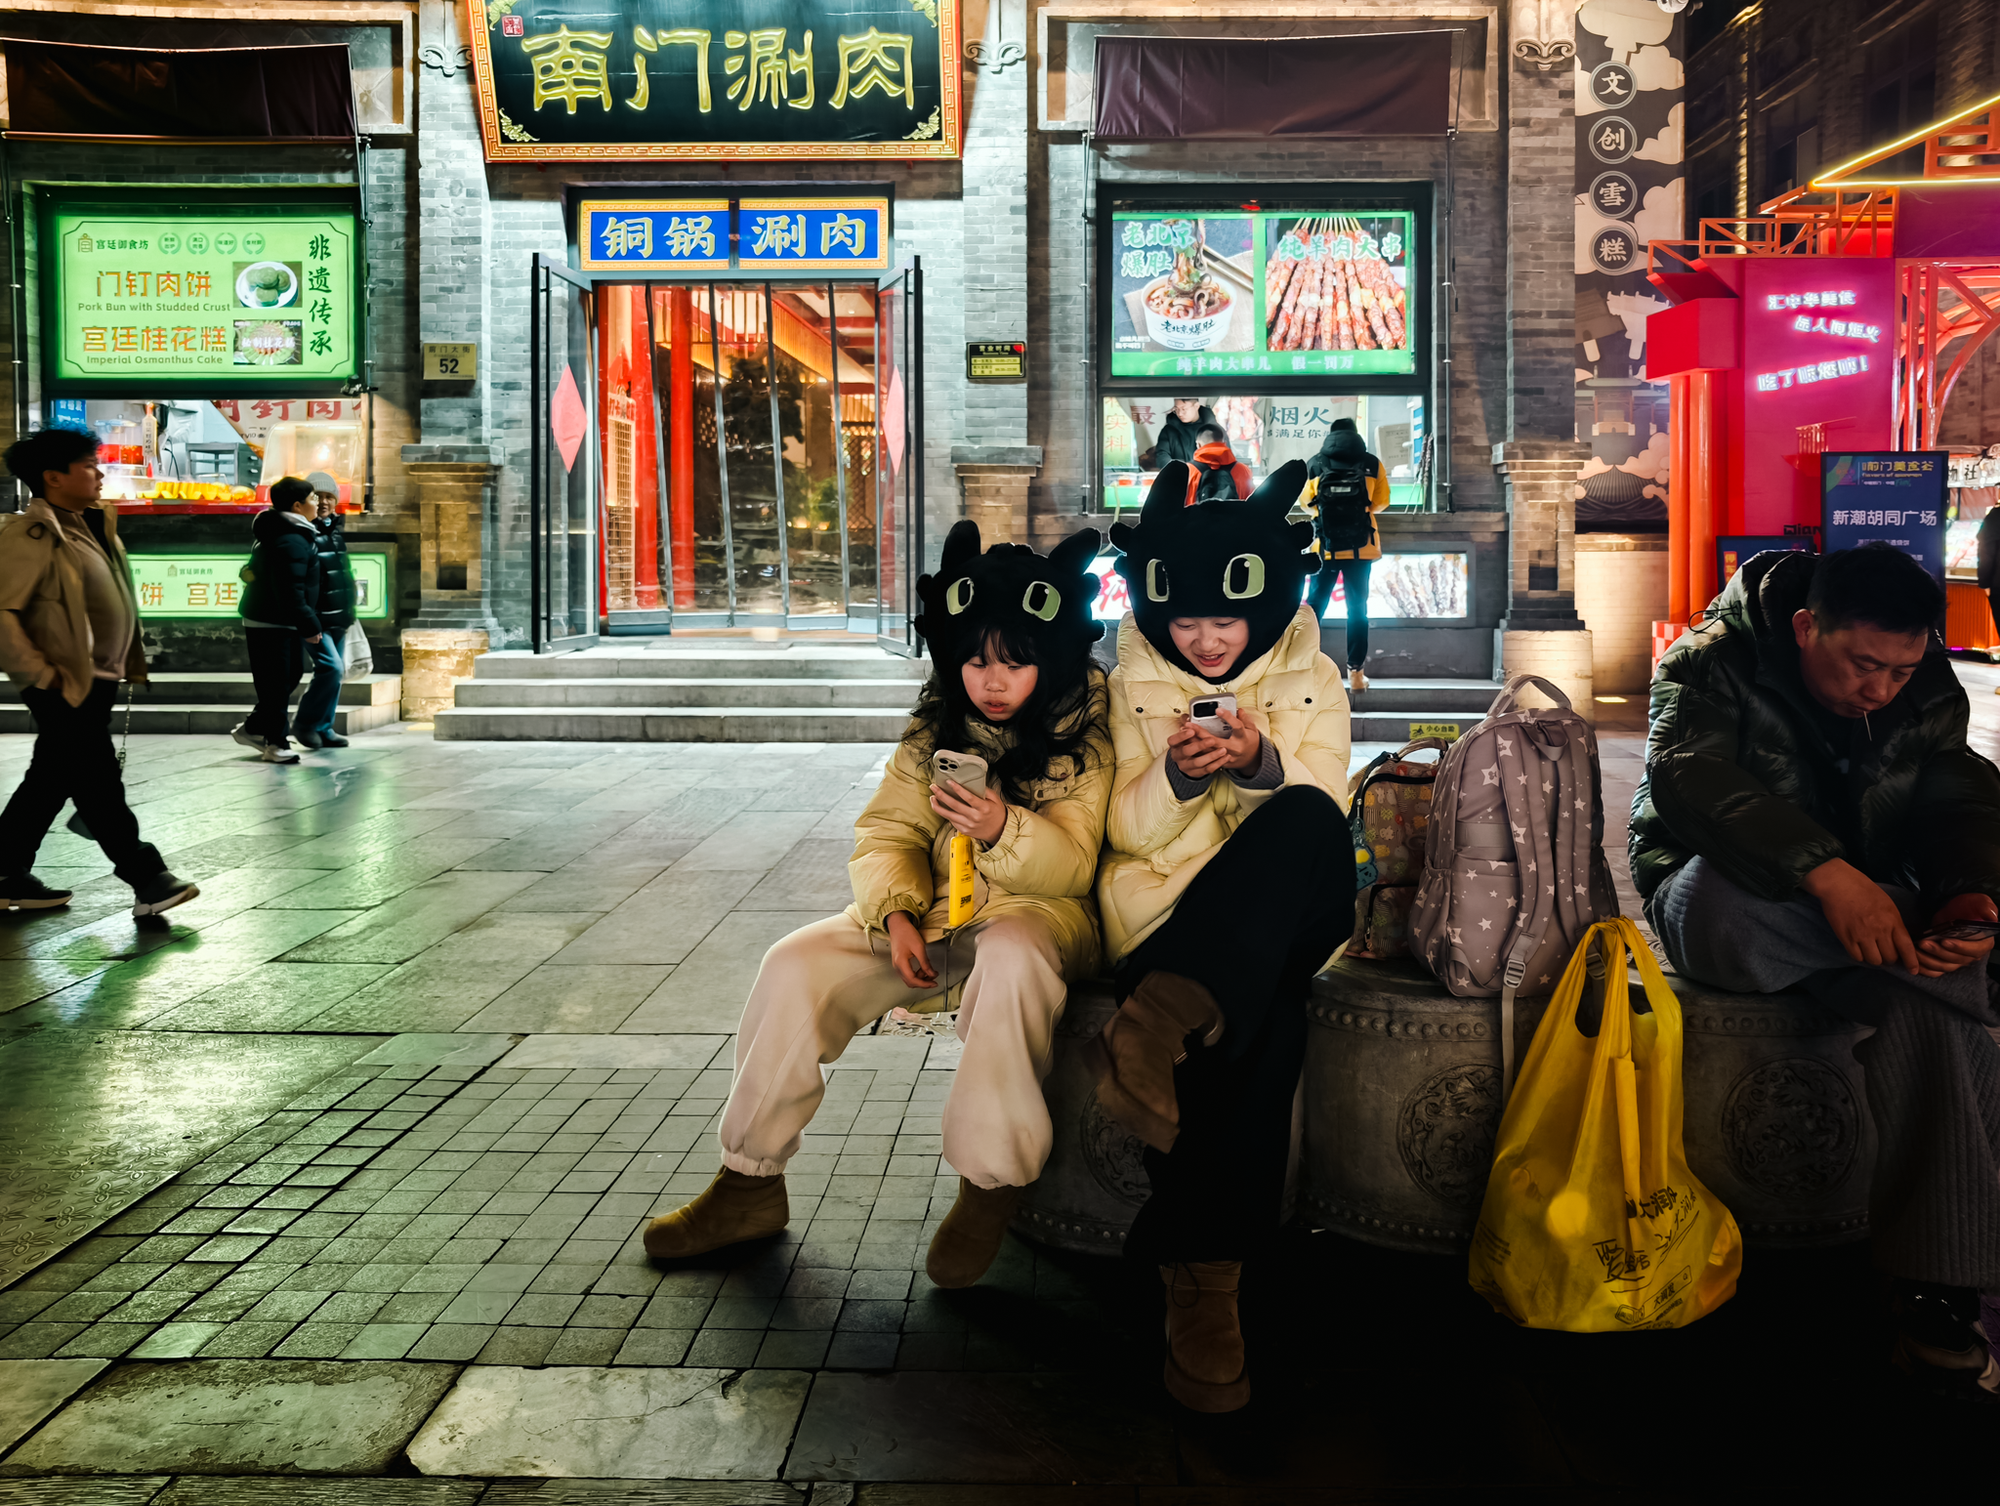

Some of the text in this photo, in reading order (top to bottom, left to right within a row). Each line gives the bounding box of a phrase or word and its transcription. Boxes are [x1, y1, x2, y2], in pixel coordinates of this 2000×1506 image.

[521, 24, 915, 115] 南门涮肉
[1597, 71, 1629, 263] 文创雪糕
[96, 239, 149, 250] 宫廷御食坊
[598, 213, 867, 259] 铜锅 涮肉
[1121, 221, 1195, 249] 老北京
[1278, 232, 1402, 262] 纯羊肉大串
[1121, 249, 1173, 278] 爆肚
[96, 271, 212, 297] 门钉肉饼
[308, 233, 333, 356] 非遗传承
[78, 303, 230, 311] Pork Bun with Studded Crust
[82, 326, 226, 352] 宫廷桂花糕
[1161, 319, 1215, 335] 老北京爆肚
[87, 355, 223, 365] Imperial Osmanthus Cake
[440, 358, 459, 374] 52
[1270, 406, 1332, 426] 烟火
[1832, 510, 1937, 526] 新潮胡同广场
[141, 582, 164, 606] 饼
